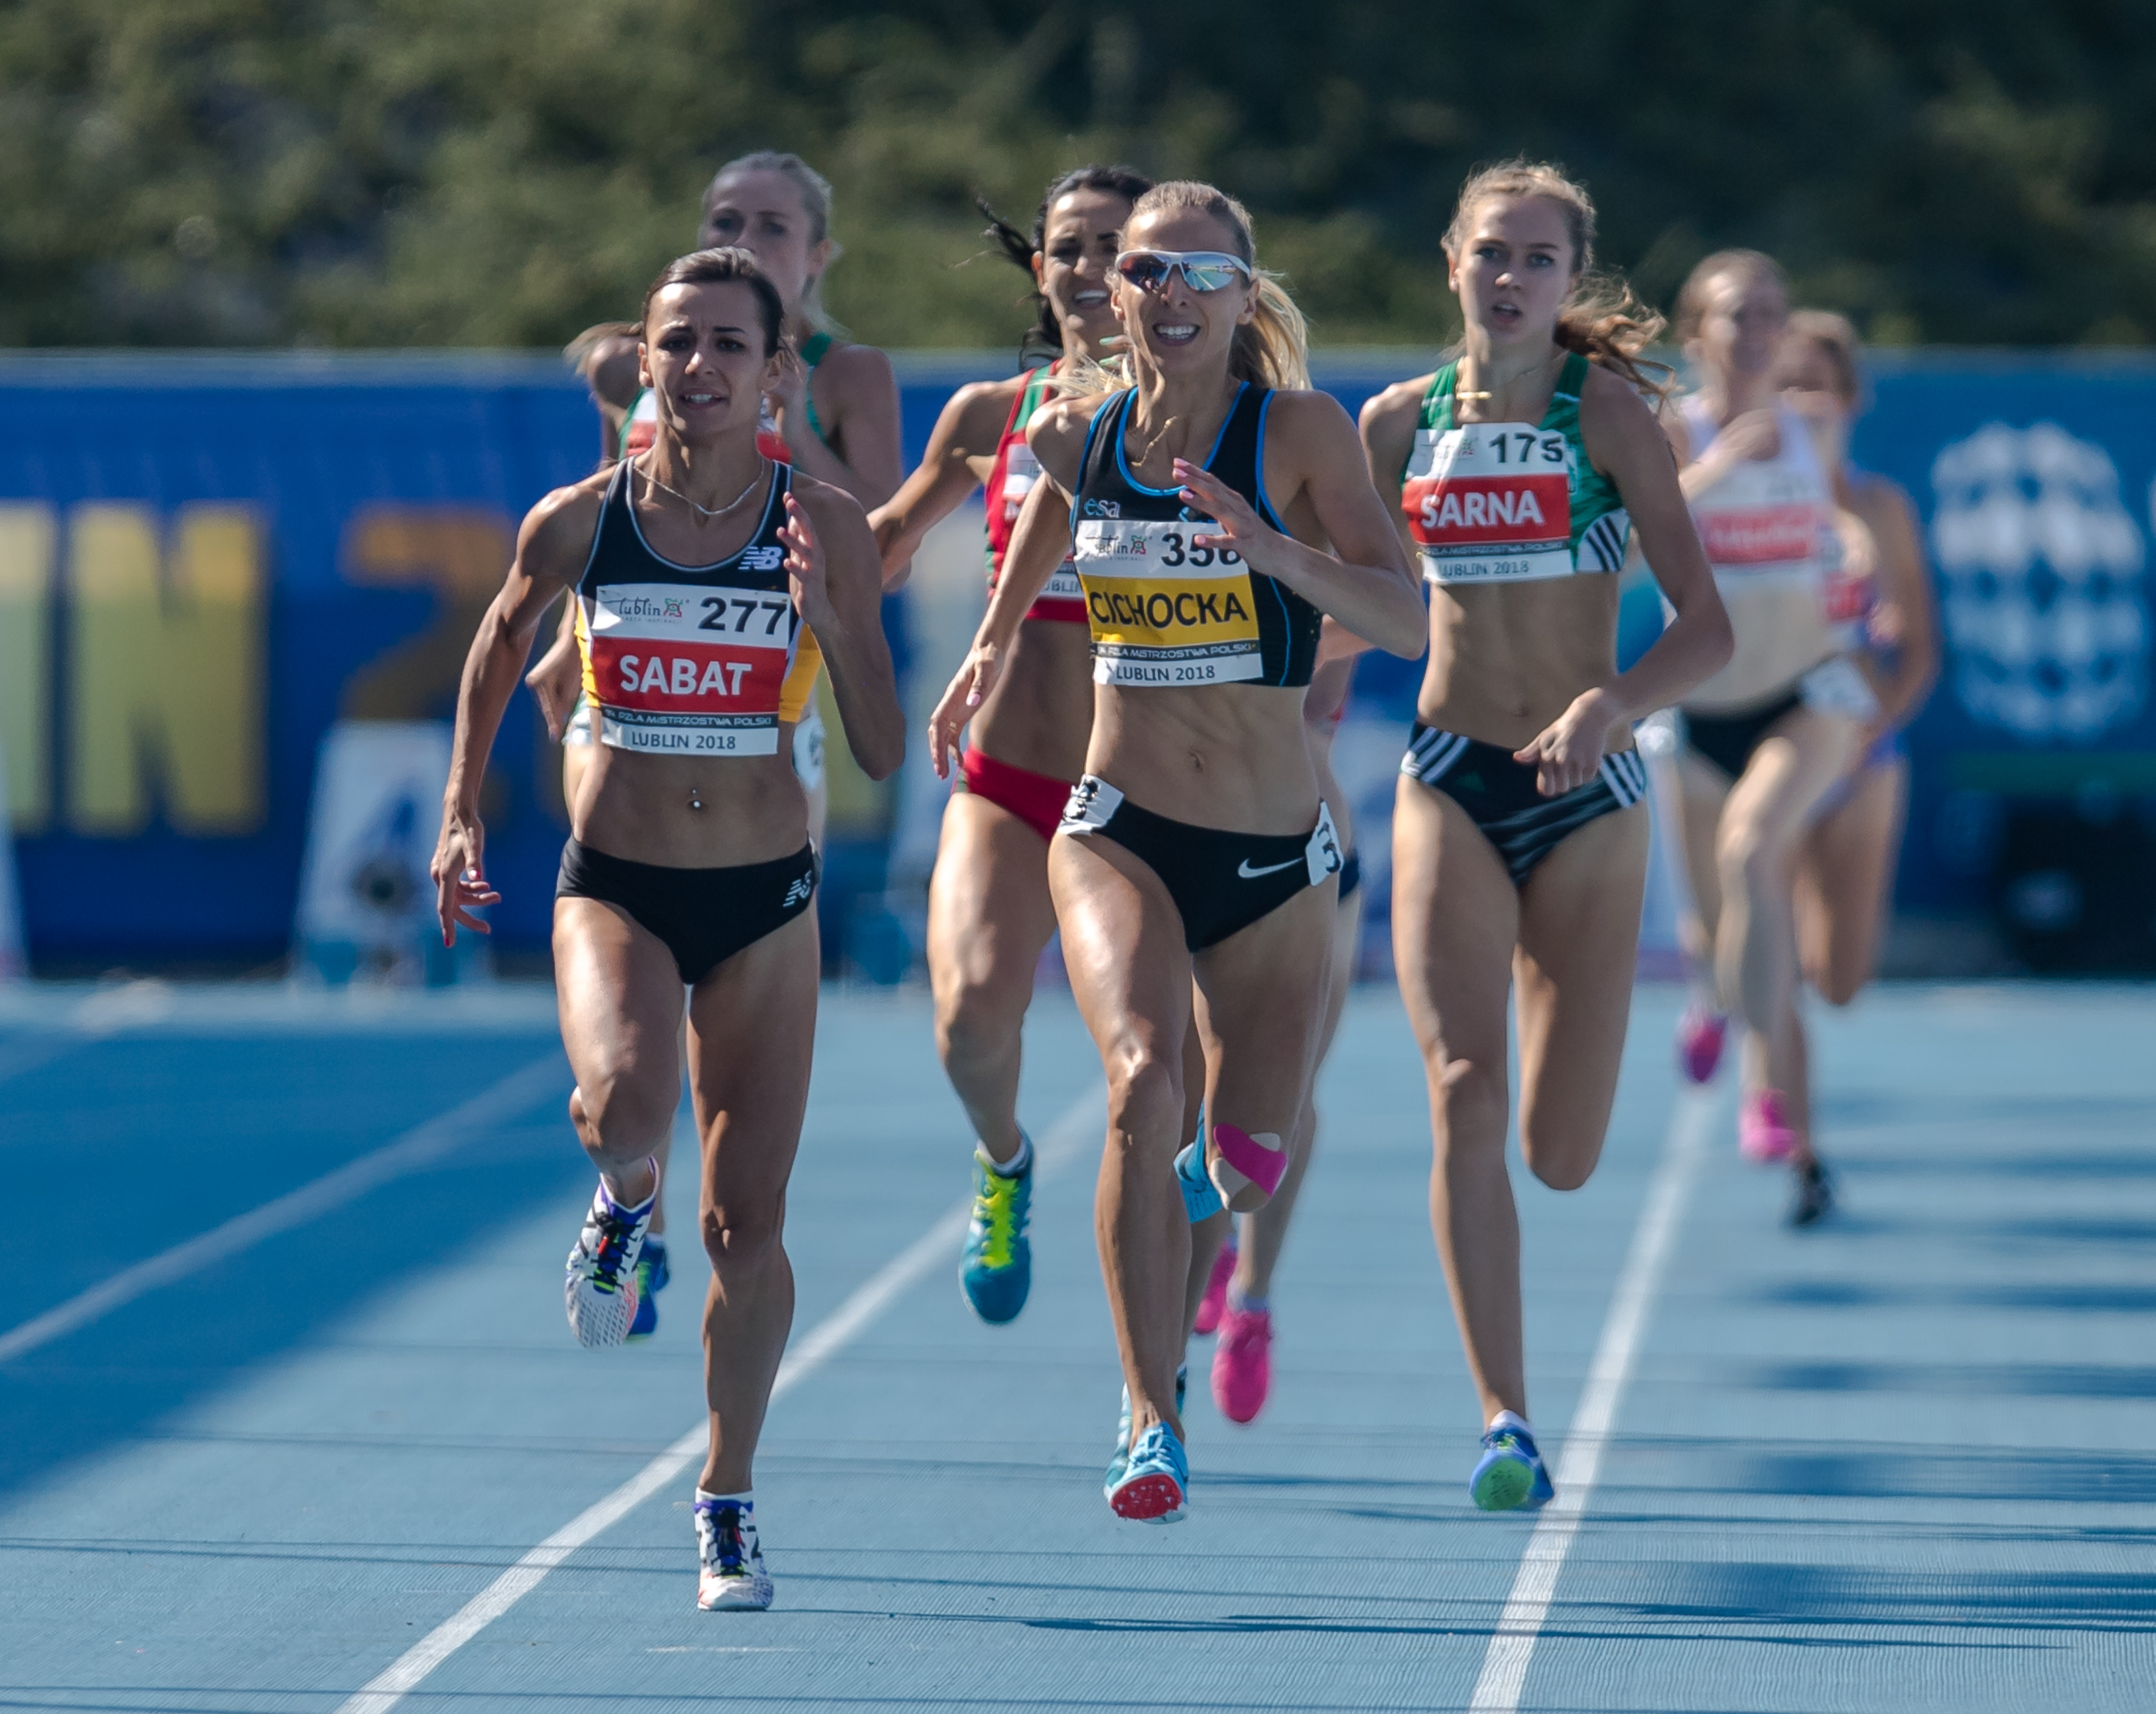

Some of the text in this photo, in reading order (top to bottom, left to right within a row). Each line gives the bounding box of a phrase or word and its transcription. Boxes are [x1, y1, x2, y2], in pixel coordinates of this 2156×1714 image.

[1489, 432, 1563, 463] 175
[1420, 490, 1546, 529] SARNA
[1439, 560, 1530, 577] UBLIN 2018
[697, 596, 787, 635] 277
[1089, 591, 1249, 628] CICHOCKA
[1210, 643, 1251, 654] POLSKI
[619, 655, 752, 696] SABAT
[1115, 665, 1215, 681] LUBLIN 2018
[733, 717, 772, 726] POLSKI
[631, 732, 736, 750] LUBLIN 2018
